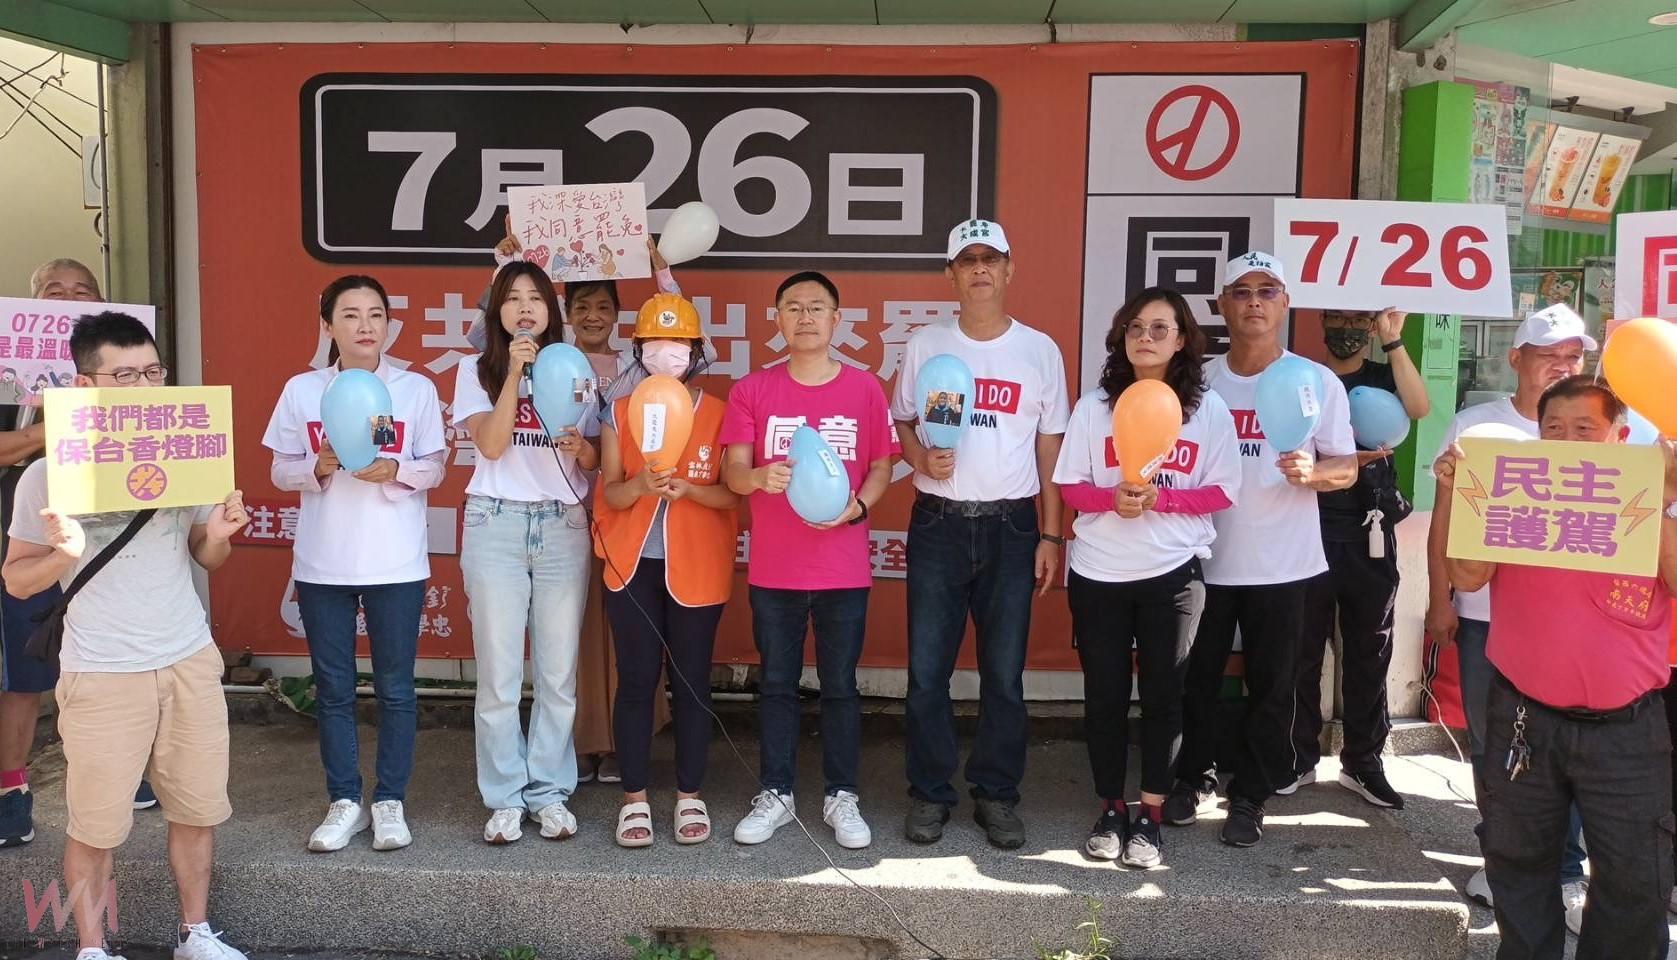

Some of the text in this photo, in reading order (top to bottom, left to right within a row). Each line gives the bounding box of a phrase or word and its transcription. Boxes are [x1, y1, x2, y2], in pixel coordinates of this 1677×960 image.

[12, 313, 71, 334] 0726
[988, 385, 1012, 407] DO
[71, 403, 210, 433] 我們都是
[55, 433, 227, 465] 保台香燈腳
[764, 415, 858, 461] 同意
[1490, 455, 1622, 505] 民主
[1484, 505, 1618, 557] 護駕
